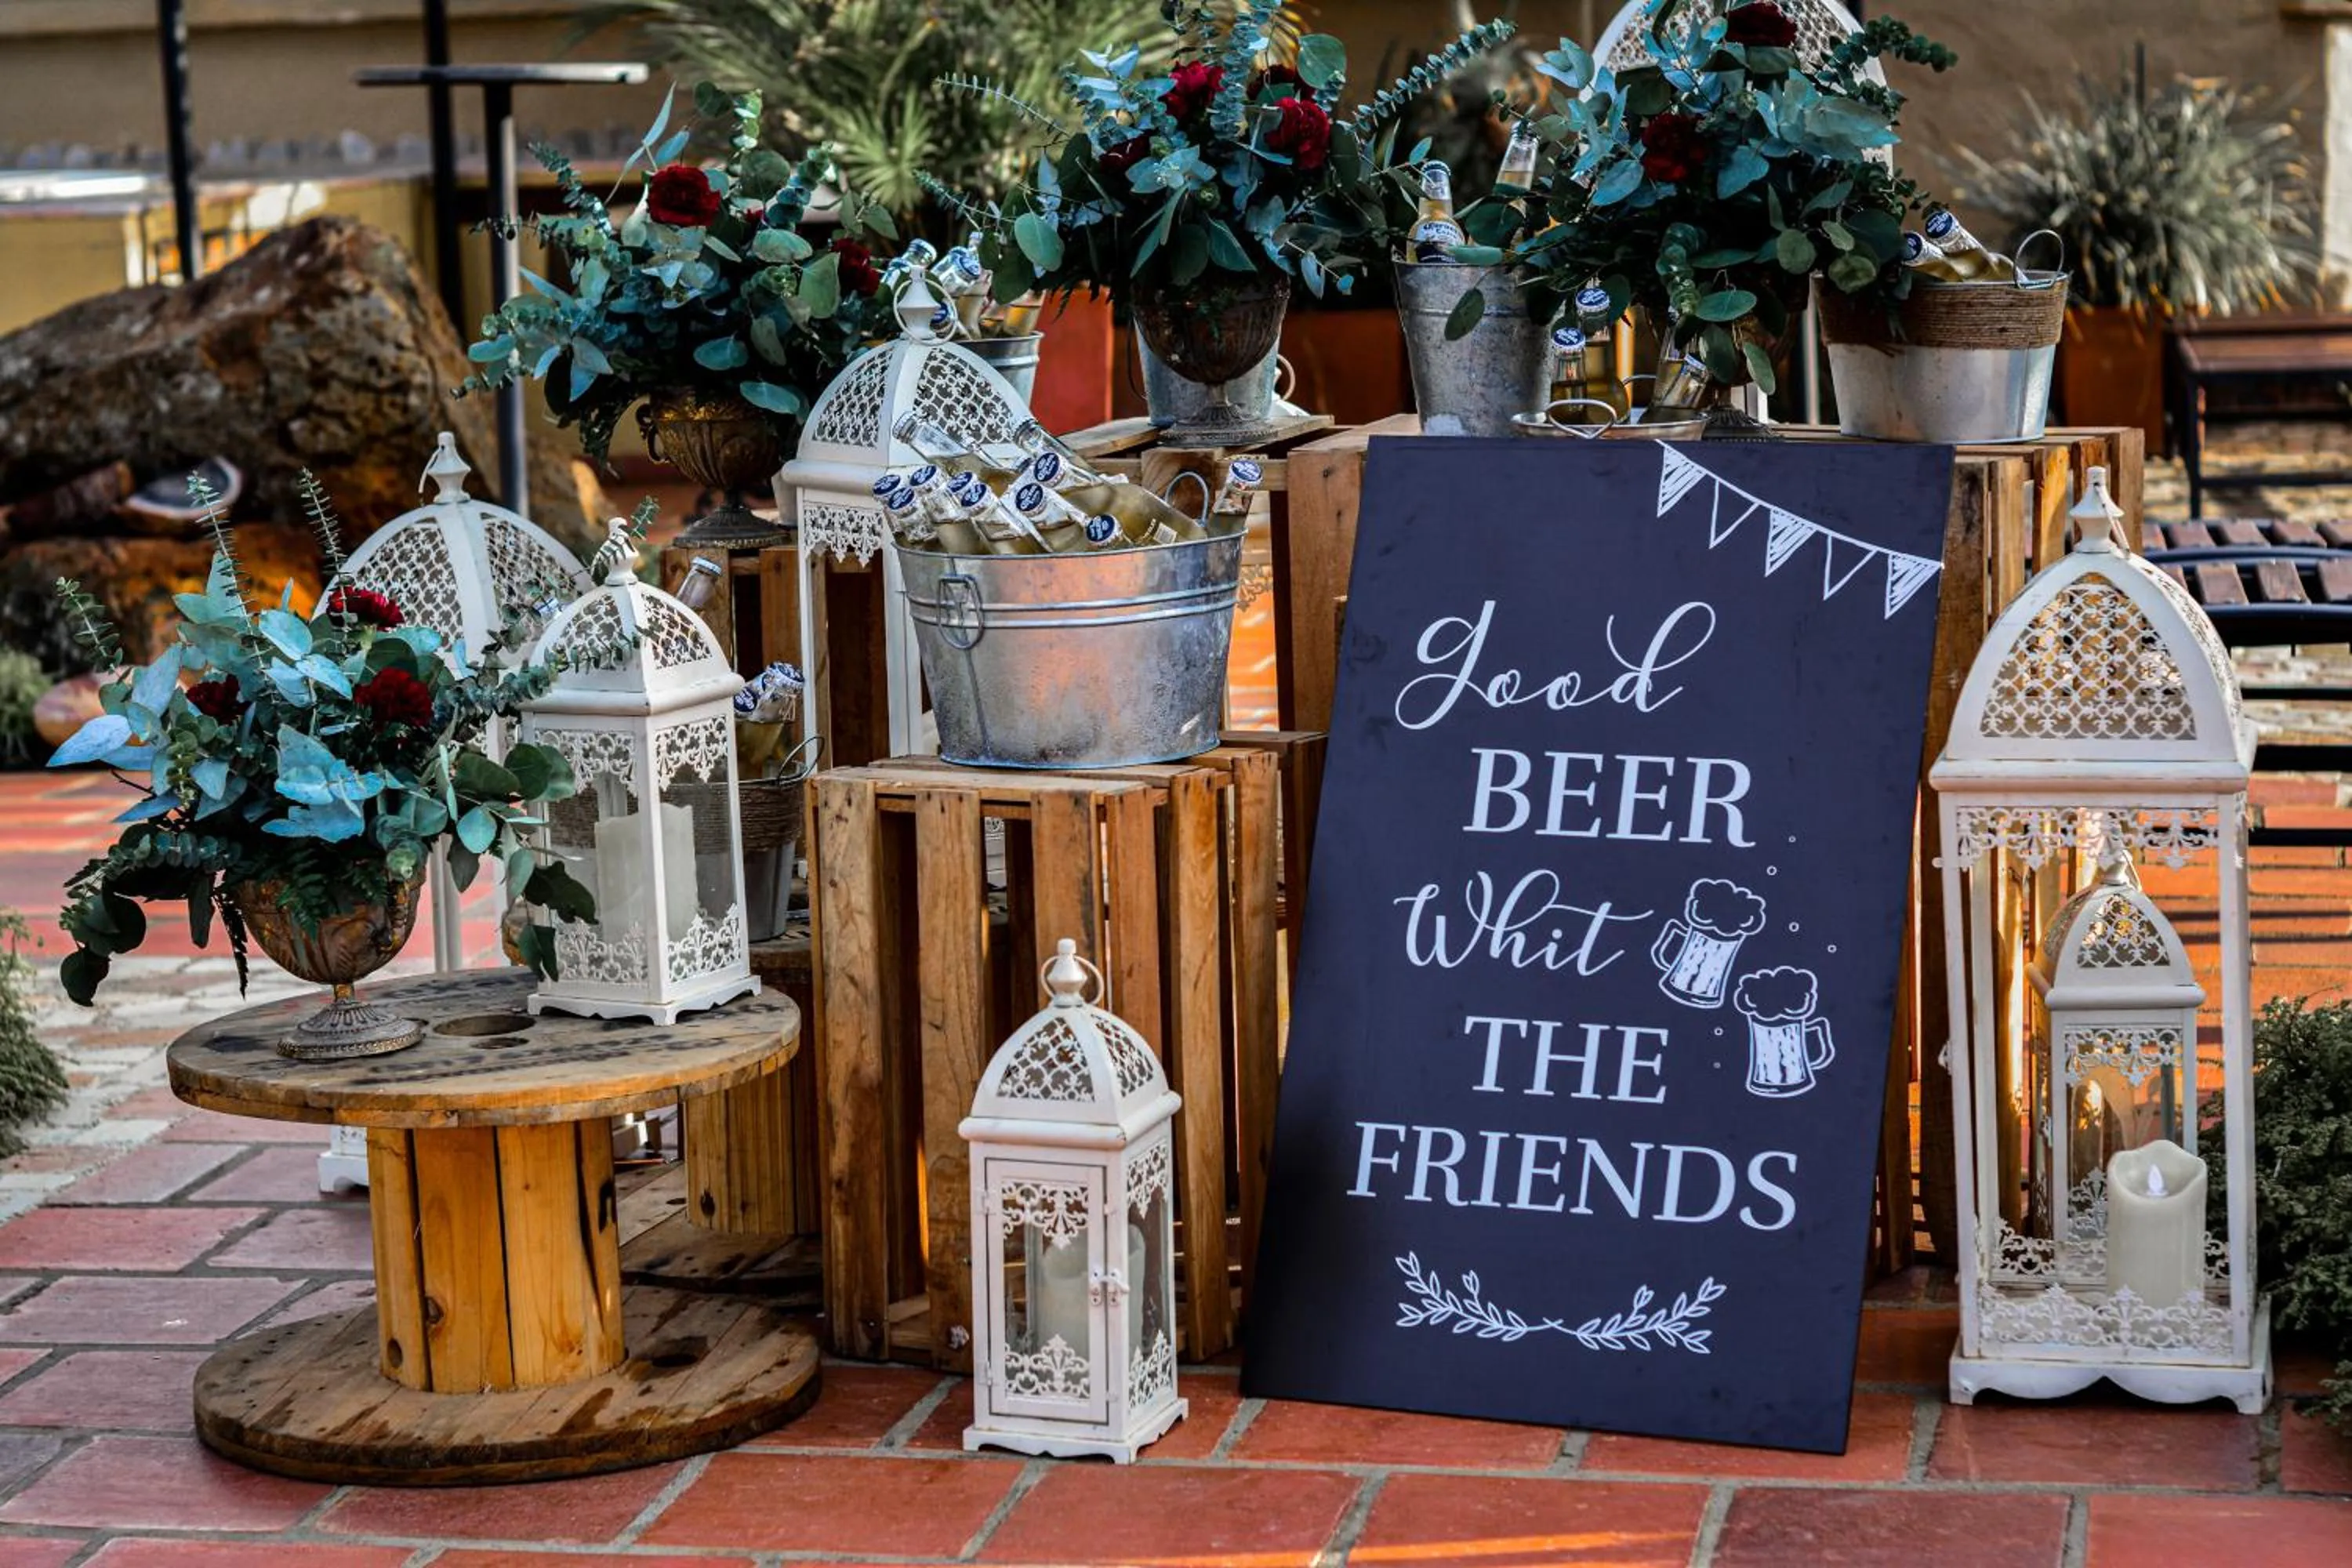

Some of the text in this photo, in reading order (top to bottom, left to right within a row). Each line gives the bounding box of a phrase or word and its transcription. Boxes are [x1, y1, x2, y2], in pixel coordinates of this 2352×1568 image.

[1463, 747, 1756, 848] BEER
[1392, 869, 1654, 976] Whit
[1464, 1016, 1669, 1105] THE
[1346, 1122, 1798, 1231] FRIENDS
